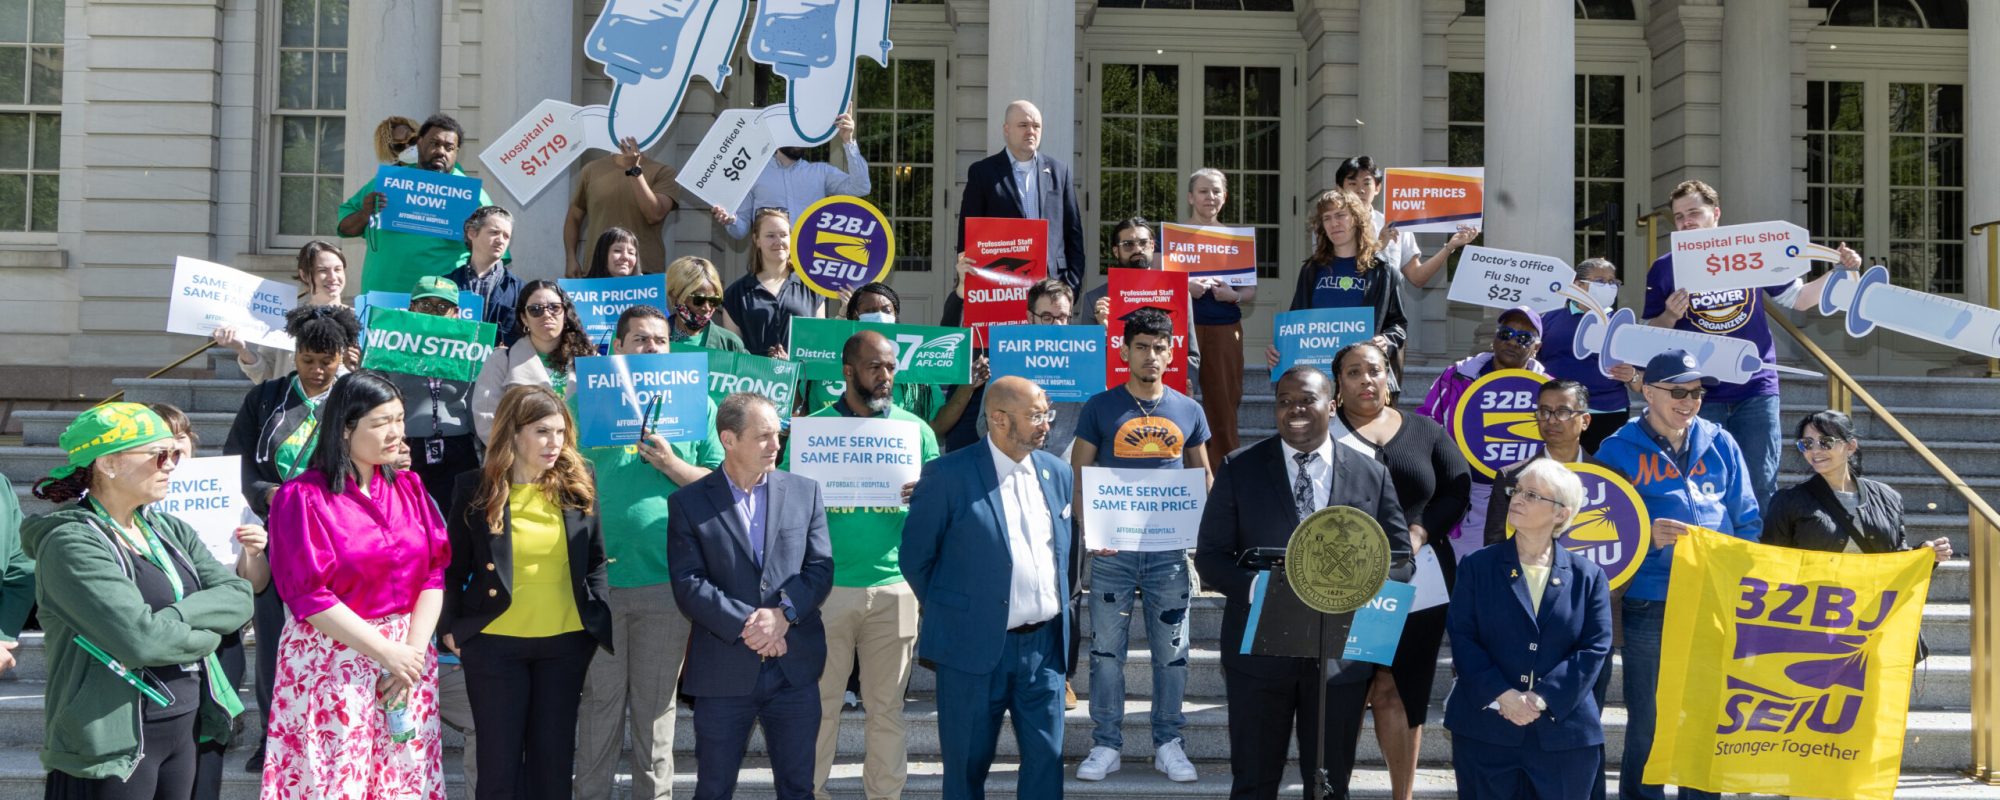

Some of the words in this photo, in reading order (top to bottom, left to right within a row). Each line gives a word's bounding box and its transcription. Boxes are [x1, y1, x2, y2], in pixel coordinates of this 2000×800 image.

[499, 124, 544, 164] Hospital
[541, 113, 555, 127] IV
[521, 134, 567, 176] $1,719
[696, 155, 723, 189] Doctor's
[719, 128, 740, 154] Office
[736, 117, 746, 128] IV
[723, 146, 752, 181] $67
[384, 177, 414, 191] FAIR
[417, 181, 472, 200] PRICING
[1392, 188, 1420, 198] FAIR
[1422, 188, 1466, 198] PRICES
[406, 193, 446, 210] NOW!
[1392, 200, 1426, 210] NOW!
[816, 211, 877, 236] 32BJ
[977, 239, 1016, 248] Professional
[1017, 238, 1033, 246] Staff
[1169, 241, 1195, 253] FAIR
[1197, 244, 1240, 255] PRICES
[1677, 237, 1732, 252] Hospital
[1735, 235, 1755, 246] Flu
[1758, 231, 1791, 243] Shot
[1169, 253, 1201, 264] NOW!
[1471, 253, 1517, 267] Doctor's
[1520, 260, 1554, 273] Office
[1706, 252, 1764, 276] $183
[809, 259, 868, 281] SEIU
[1484, 270, 1501, 280] Flu
[1503, 273, 1531, 286] Shot
[192, 274, 230, 290] SAME
[183, 286, 222, 301] SAME
[567, 291, 598, 303] FAIR
[602, 287, 658, 302] PRICING
[967, 287, 1029, 303] SOLIDARI
[1120, 289, 1158, 297] Professional
[1487, 284, 1522, 303] $23
[1691, 290, 1745, 309] POWER
[1280, 323, 1306, 337] FAIR
[1308, 321, 1366, 334] PRICING
[1698, 311, 1747, 330] ORGANIZERS
[366, 328, 422, 354] NION
[421, 336, 494, 363] STRON
[998, 340, 1032, 353] FAIR
[1035, 339, 1097, 353] PRICING
[1299, 336, 1340, 349] NOW!
[795, 348, 836, 359] District
[916, 351, 955, 359] AFSCME
[1025, 355, 1070, 368] NOW!
[915, 360, 954, 368] AFL-CIO
[632, 370, 699, 387] PRICING
[709, 371, 789, 401] TRONG
[621, 389, 672, 406] NOW!
[808, 436, 847, 448] SAME
[849, 436, 907, 450] SERVICE,
[1124, 425, 1178, 448] NYPIRG
[800, 452, 840, 463] SAME
[842, 452, 873, 464] FAIR
[876, 453, 913, 465] PRICE
[1632, 453, 1707, 487] Mes
[167, 478, 222, 494] RVICE,
[1098, 485, 1133, 497] SAME
[1136, 486, 1191, 497] SERVICE,
[153, 499, 180, 513] AIR
[184, 495, 230, 511] PRICE
[1092, 499, 1127, 511] SAME
[1130, 501, 1158, 512] FAIR
[1161, 499, 1198, 512] PRICE
[1735, 576, 1899, 631] 32BJ
[1716, 693, 1863, 735] SEIU
[1714, 740, 1779, 757] Stronger
[1782, 739, 1860, 761] Together
